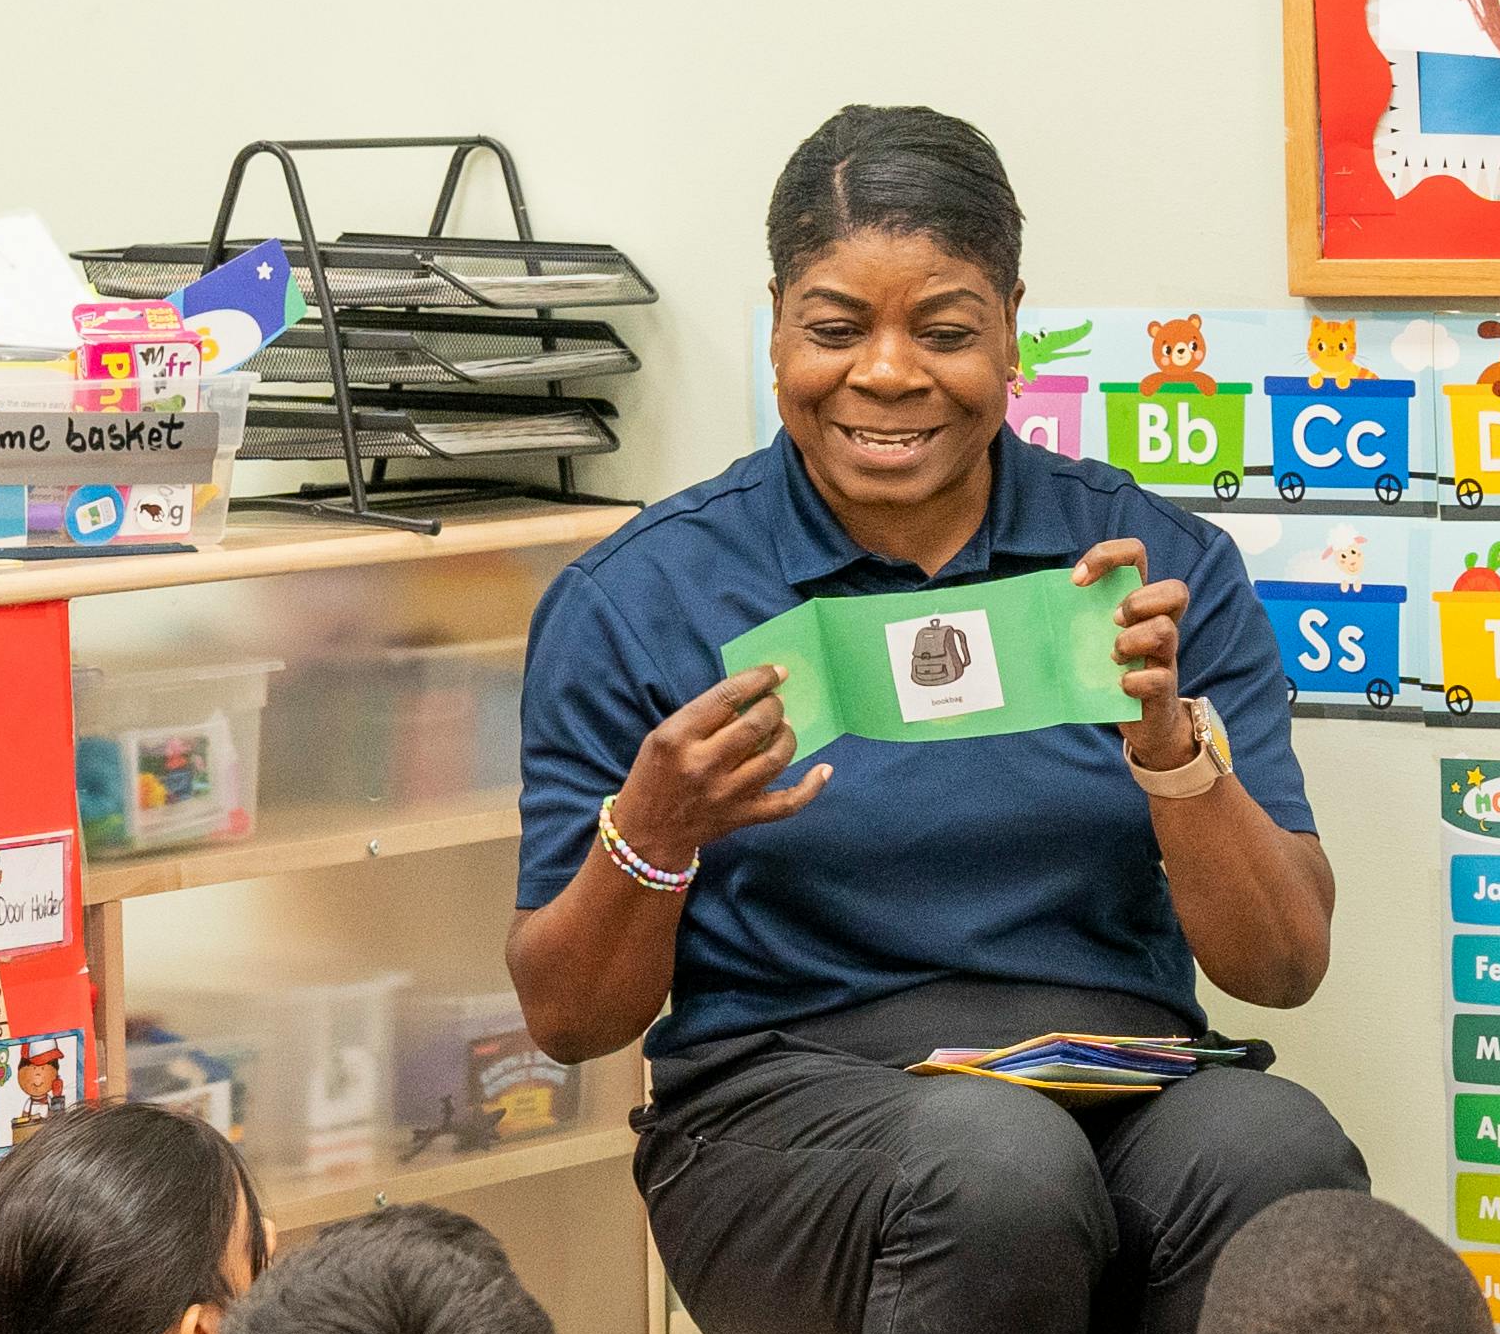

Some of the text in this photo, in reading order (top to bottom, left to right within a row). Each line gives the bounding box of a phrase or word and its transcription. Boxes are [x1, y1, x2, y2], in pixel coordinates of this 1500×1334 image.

[66, 413, 185, 453] basket
[1137, 403, 1220, 465] Bb
[1292, 406, 1388, 470] Cc
[1296, 609, 1365, 672] Ss
[931, 696, 963, 706] bookbag
